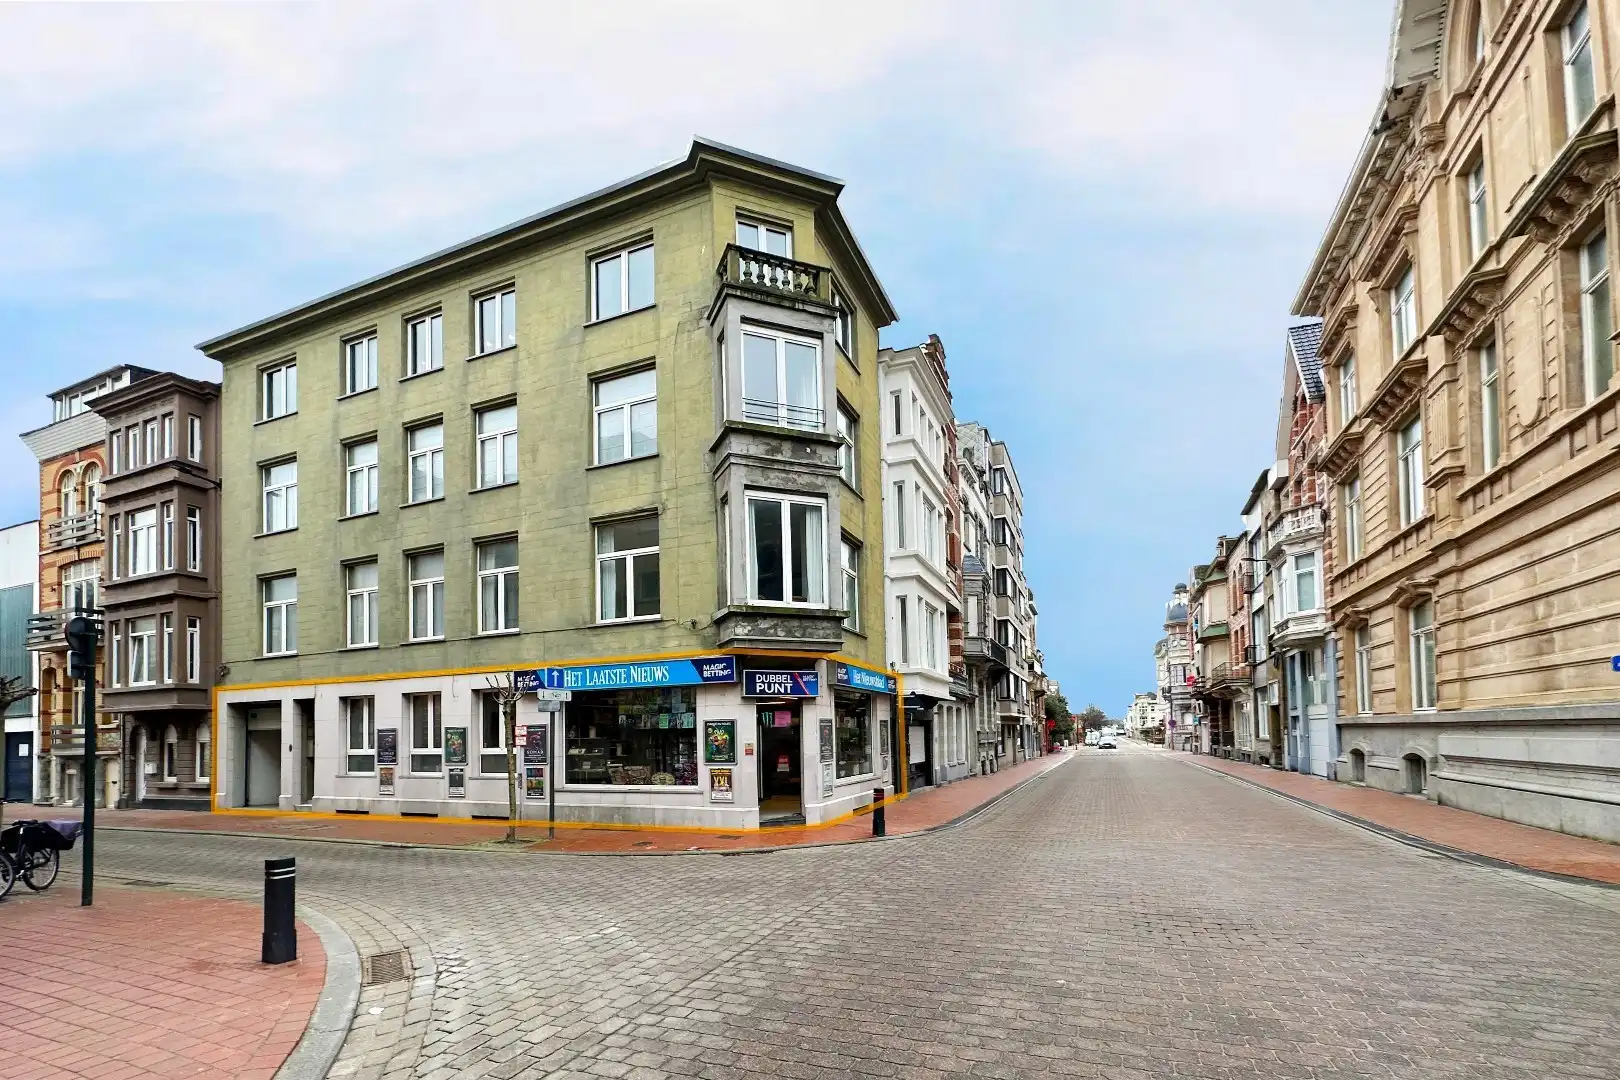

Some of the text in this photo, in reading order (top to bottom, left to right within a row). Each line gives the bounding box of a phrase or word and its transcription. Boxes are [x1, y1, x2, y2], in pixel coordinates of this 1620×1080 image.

[703, 663, 727, 671] MAGIC
[703, 669, 731, 677] BETTING
[755, 674, 793, 683] DUBBEL
[756, 683, 793, 693] PUNT
